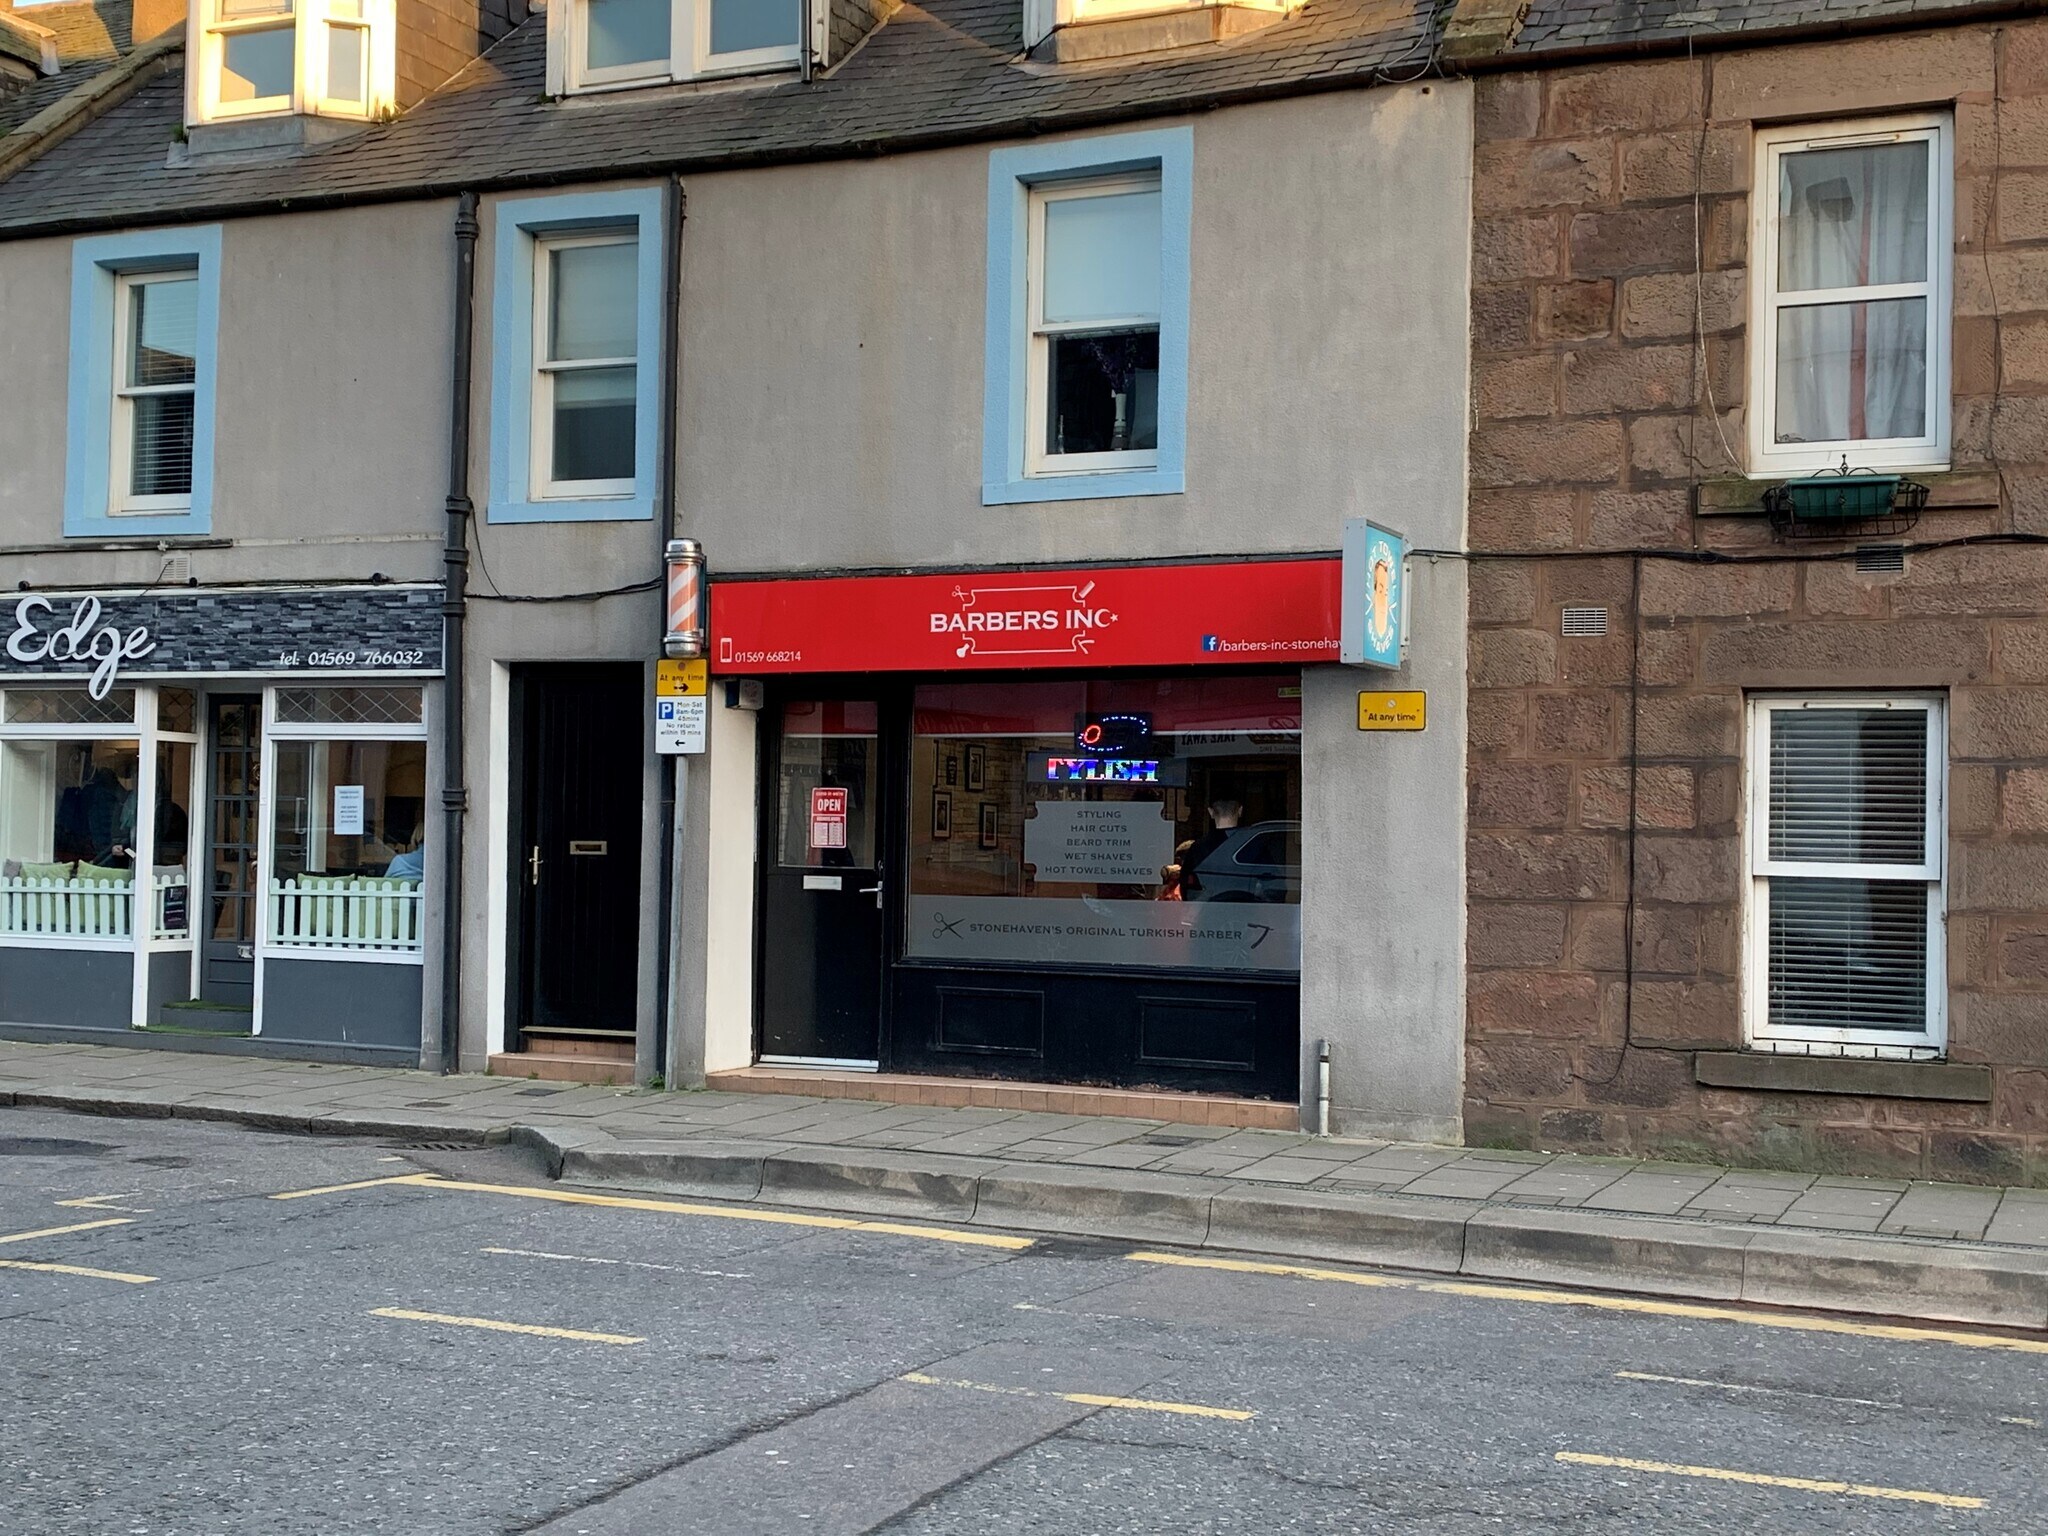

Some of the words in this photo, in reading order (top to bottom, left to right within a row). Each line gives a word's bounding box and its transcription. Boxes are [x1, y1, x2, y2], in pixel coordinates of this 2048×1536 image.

[930, 610, 1059, 633] BARBERS
[1065, 608, 1111, 629] INC
[6, 595, 157, 701] Edge
[279, 651, 300, 666] tel:
[308, 651, 356, 666] 01569
[363, 651, 424, 666] 766032
[734, 651, 765, 663] 01569
[766, 650, 802, 663] 668214
[1368, 712, 1378, 721] At
[1379, 714, 1396, 723] any
[1397, 712, 1417, 721] time
[817, 798, 841, 812] OPEN
[1076, 810, 1122, 819] STYLING
[1070, 824, 1096, 833] HAIR
[1099, 824, 1128, 833] CUTS
[1066, 838, 1102, 847] BEARD
[1105, 838, 1131, 847] TRIM
[1064, 852, 1087, 861] WET
[1090, 852, 1133, 861] SHAVES
[1044, 865, 1067, 874] HOT
[1069, 866, 1107, 875] TOWEL
[1110, 866, 1153, 875] SHAVES
[969, 923, 1063, 935] STONEHAVEN'S
[1066, 926, 1126, 937] ORIGINAL
[1129, 927, 1185, 938] TURKISH
[1189, 929, 1242, 940] BARBER
